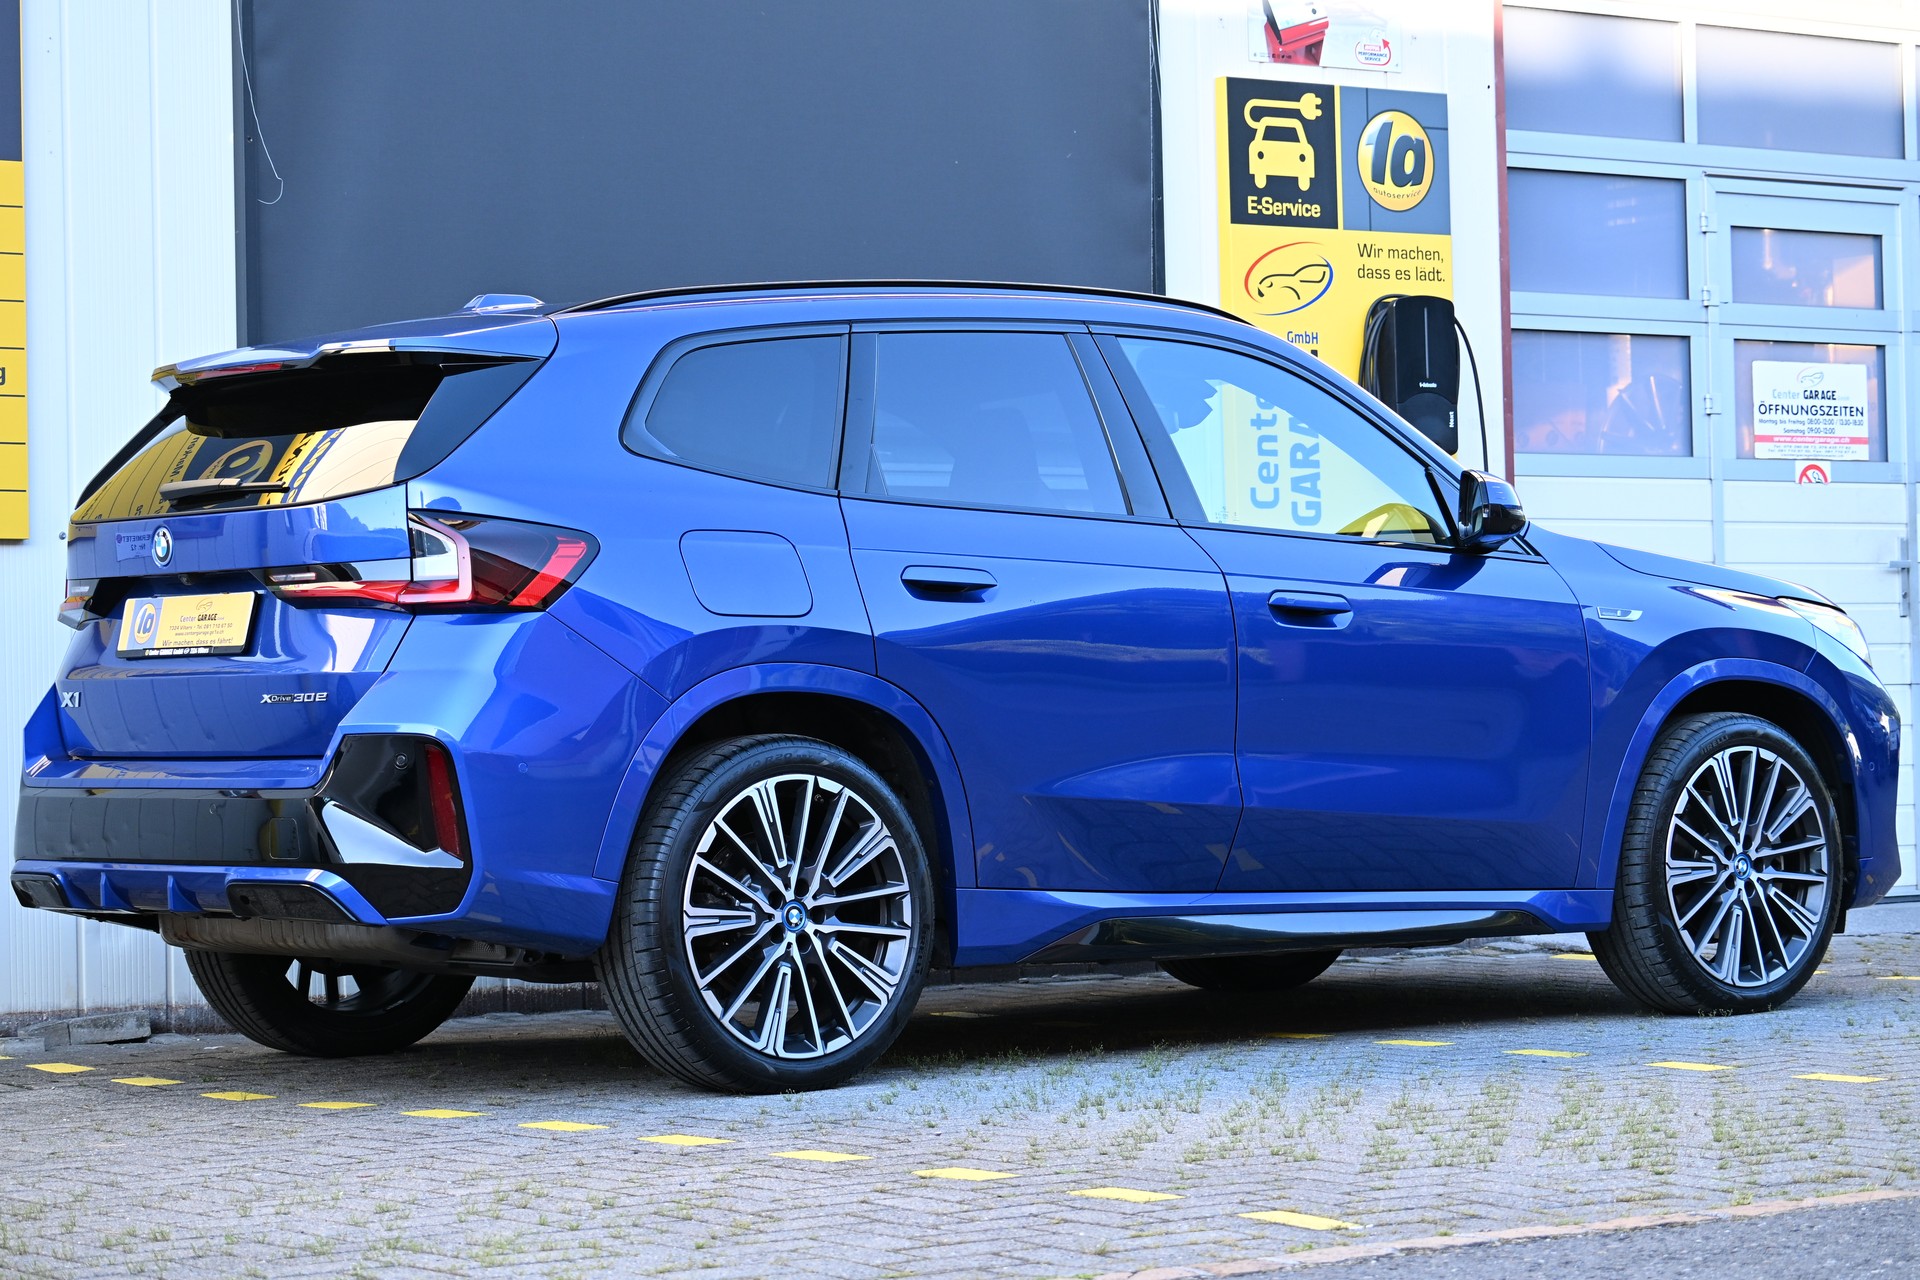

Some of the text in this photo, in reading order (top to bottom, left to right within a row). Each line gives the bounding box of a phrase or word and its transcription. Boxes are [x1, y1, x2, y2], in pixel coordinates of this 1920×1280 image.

[1373, 187, 1422, 200] autoservice
[1247, 195, 1321, 218] E-Service
[1357, 243, 1444, 263] Wir machen,
[1357, 264, 1446, 283] dass es lädt.
[1287, 331, 1319, 345] GmbH
[1772, 389, 1800, 400] Center
[1803, 389, 1837, 401] GARAGE
[1758, 400, 1864, 417] ÖFFNUNGSZEITEN
[1783, 427, 1806, 435] Samstag
[179, 615, 196, 623] Center
[197, 613, 218, 622] GARAGE
[162, 639, 172, 647] Wir
[60, 691, 80, 708] X1
